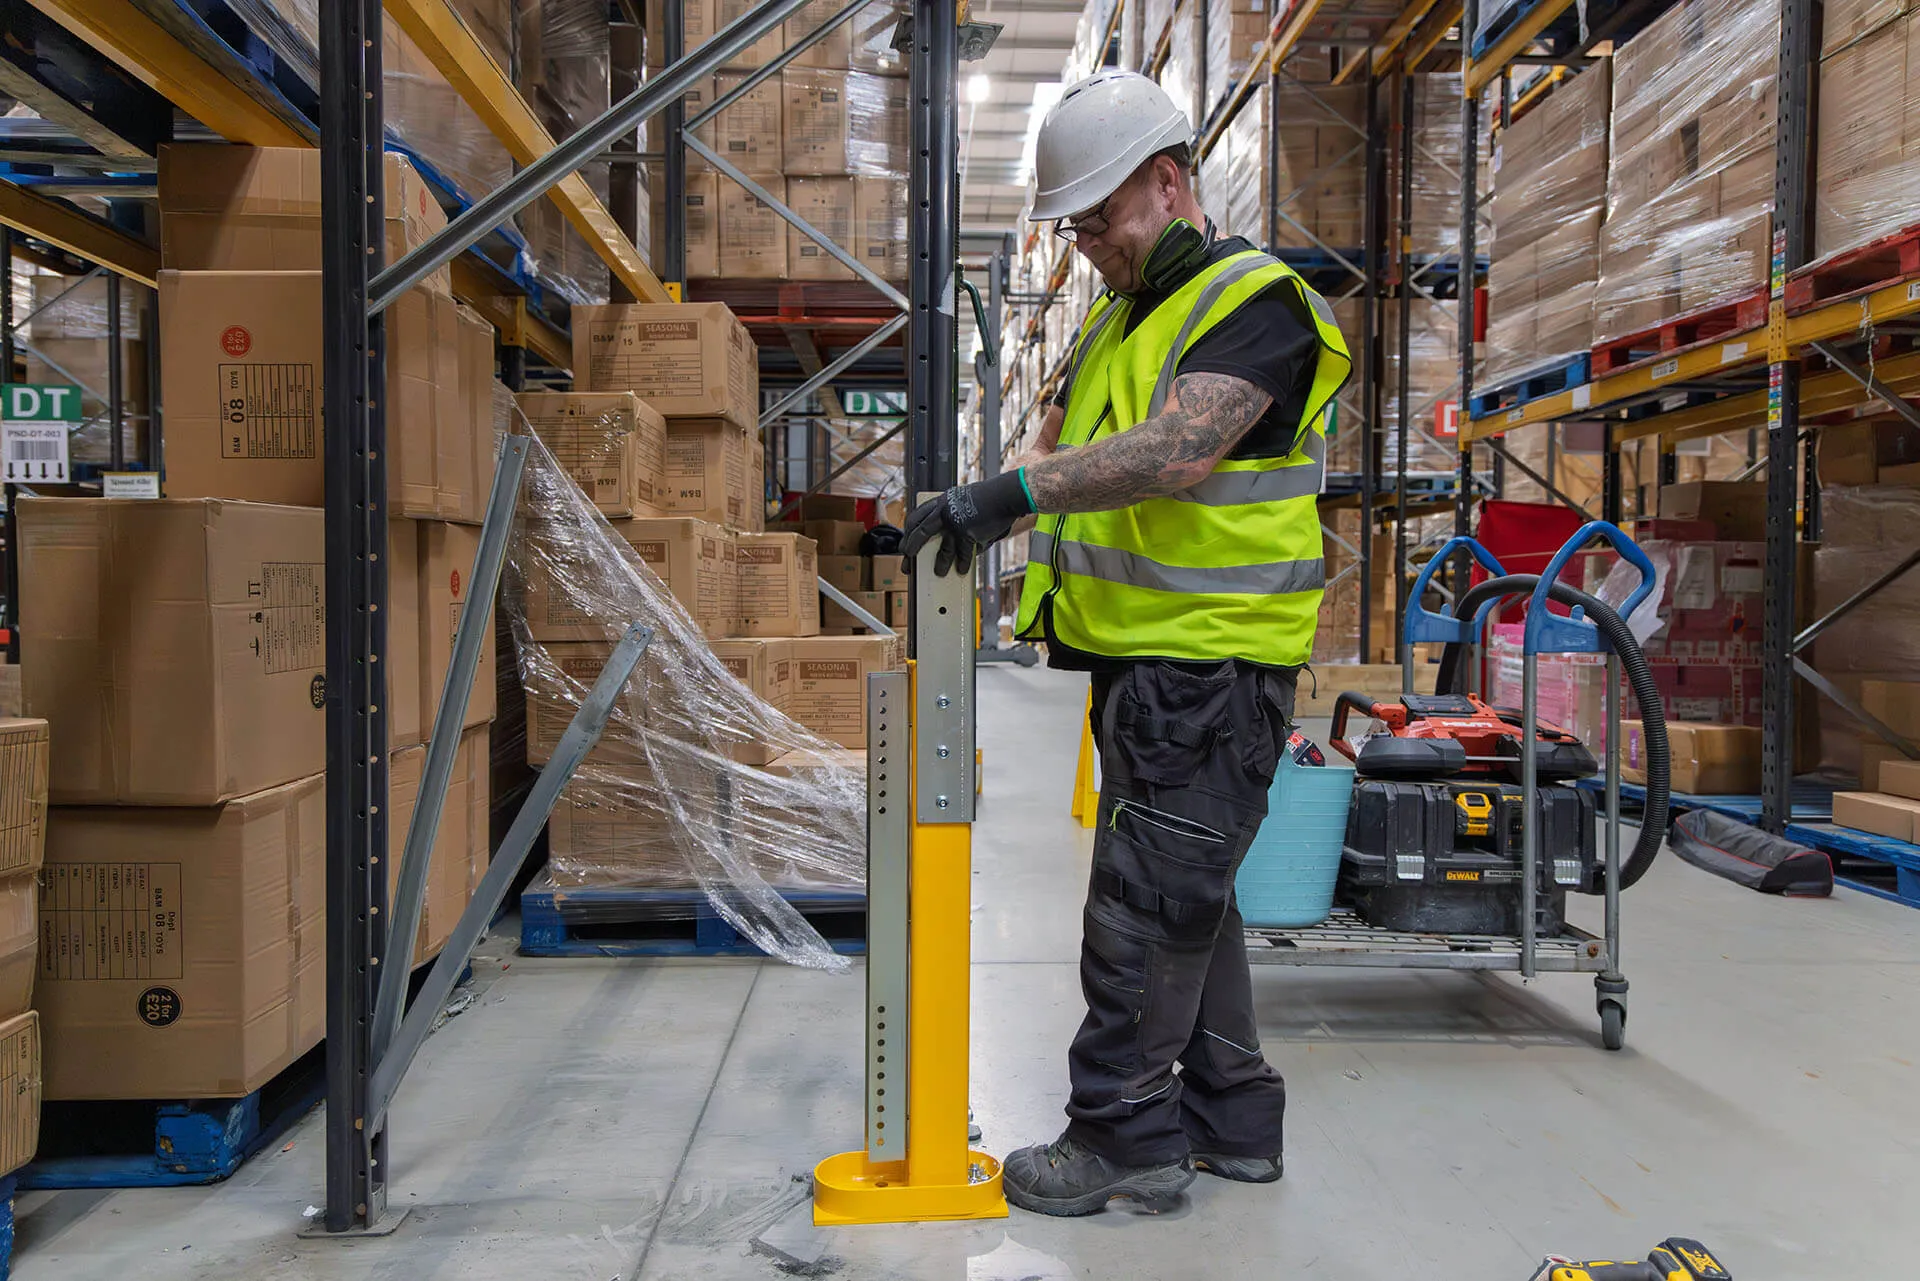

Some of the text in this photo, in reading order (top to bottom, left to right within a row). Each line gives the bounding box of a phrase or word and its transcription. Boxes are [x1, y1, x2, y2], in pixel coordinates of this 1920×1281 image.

[646, 324, 690, 332] SEASONAL
[623, 338, 632, 346] 15
[12, 387, 70, 418] DT
[230, 399, 244, 423] 08
[597, 478, 616, 486] B&M
[680, 489, 701, 498] B&M
[155, 887, 163, 907] B&M
[155, 914, 165, 927] 08
[147, 993, 159, 1021] £20
[162, 1004, 172, 1018] for
